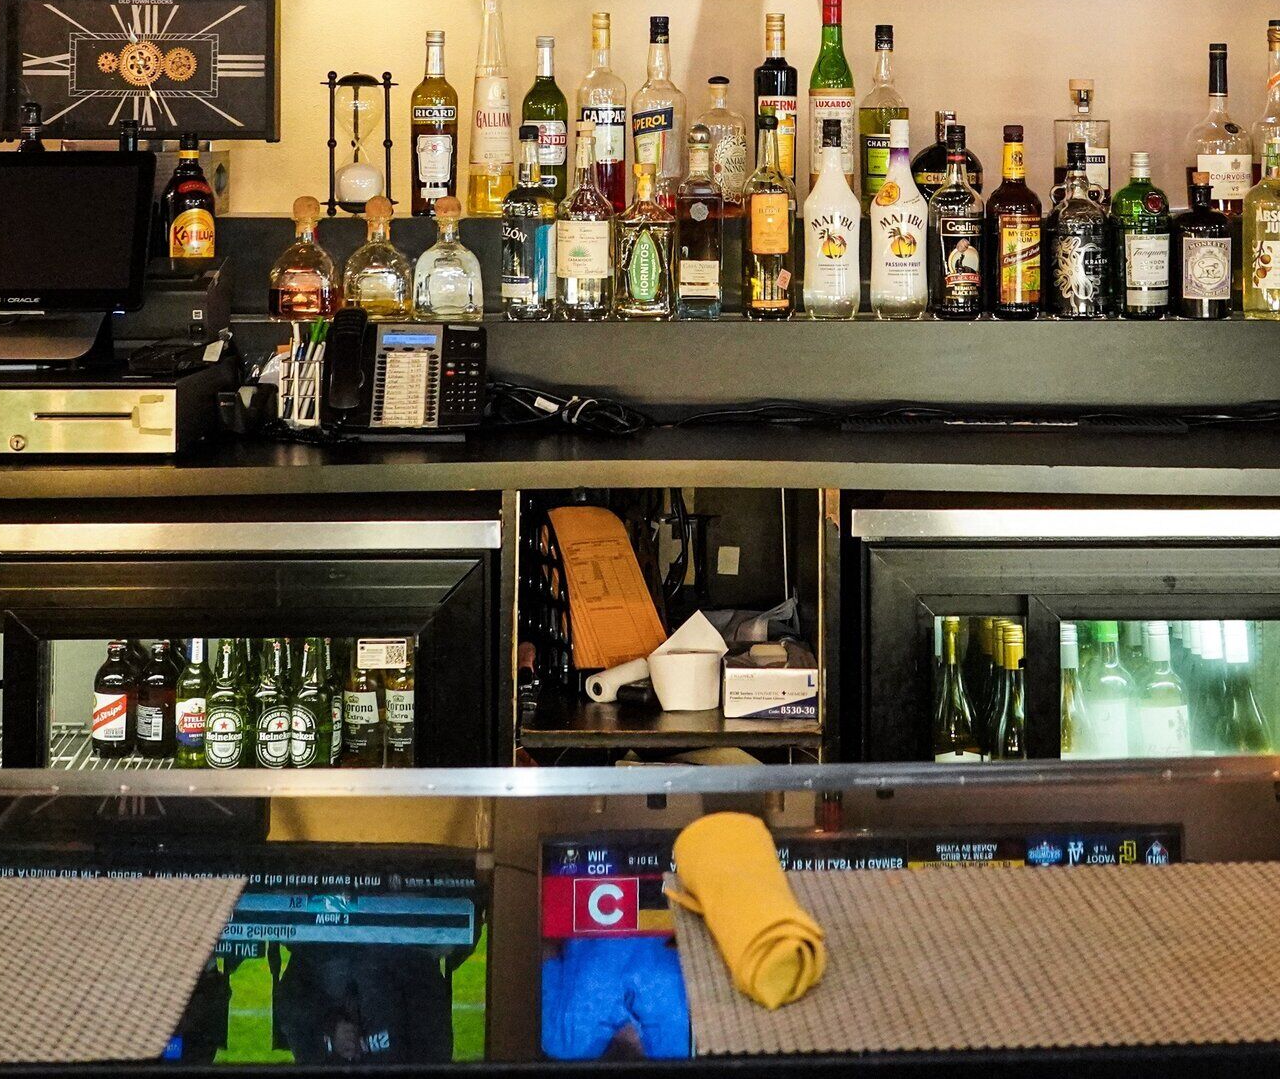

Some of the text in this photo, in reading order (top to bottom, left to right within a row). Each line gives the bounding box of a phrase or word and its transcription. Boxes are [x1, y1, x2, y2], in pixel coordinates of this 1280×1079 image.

[815, 100, 852, 108] LUXARDO
[414, 109, 455, 118] RICARD
[640, 243, 650, 296] HORNITOS
[807, 674, 815, 687] L
[781, 706, 815, 714] 8530-30
[206, 731, 243, 741] Heineken
